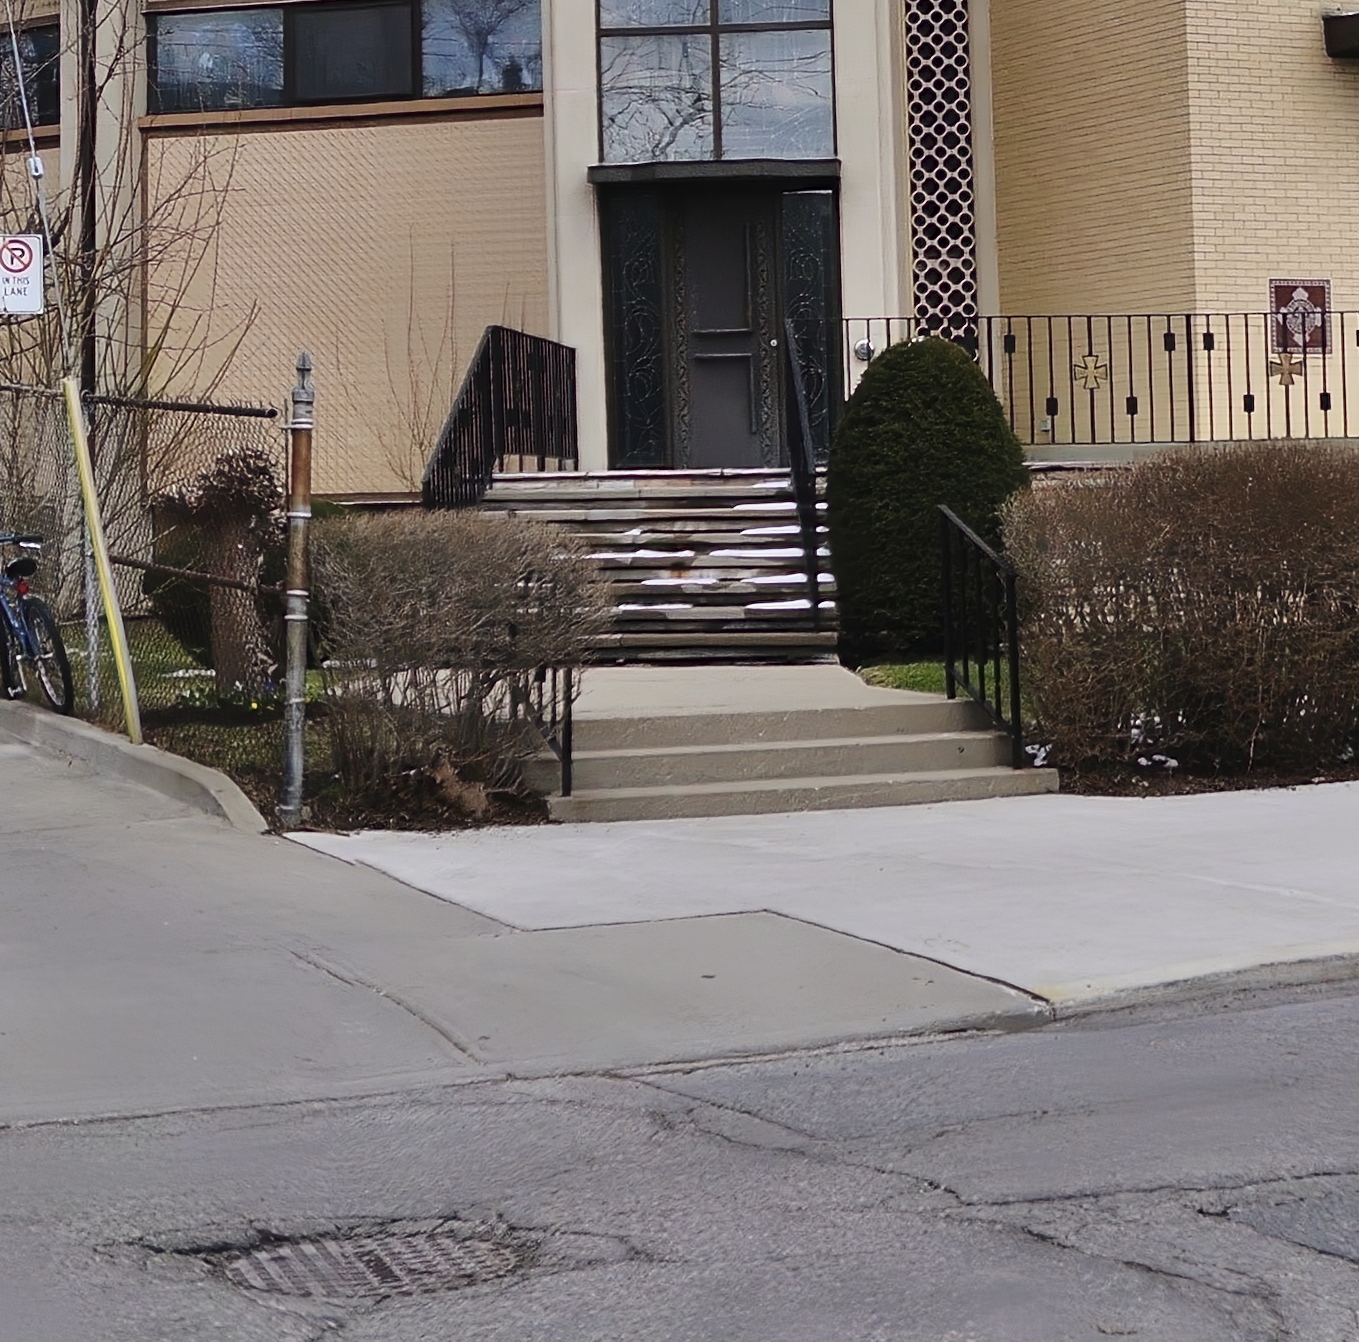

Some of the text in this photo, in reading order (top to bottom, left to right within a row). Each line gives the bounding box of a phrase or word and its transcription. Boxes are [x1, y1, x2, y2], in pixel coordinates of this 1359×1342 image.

[2, 277, 30, 285] IN THIS
[4, 287, 28, 296] LANE
